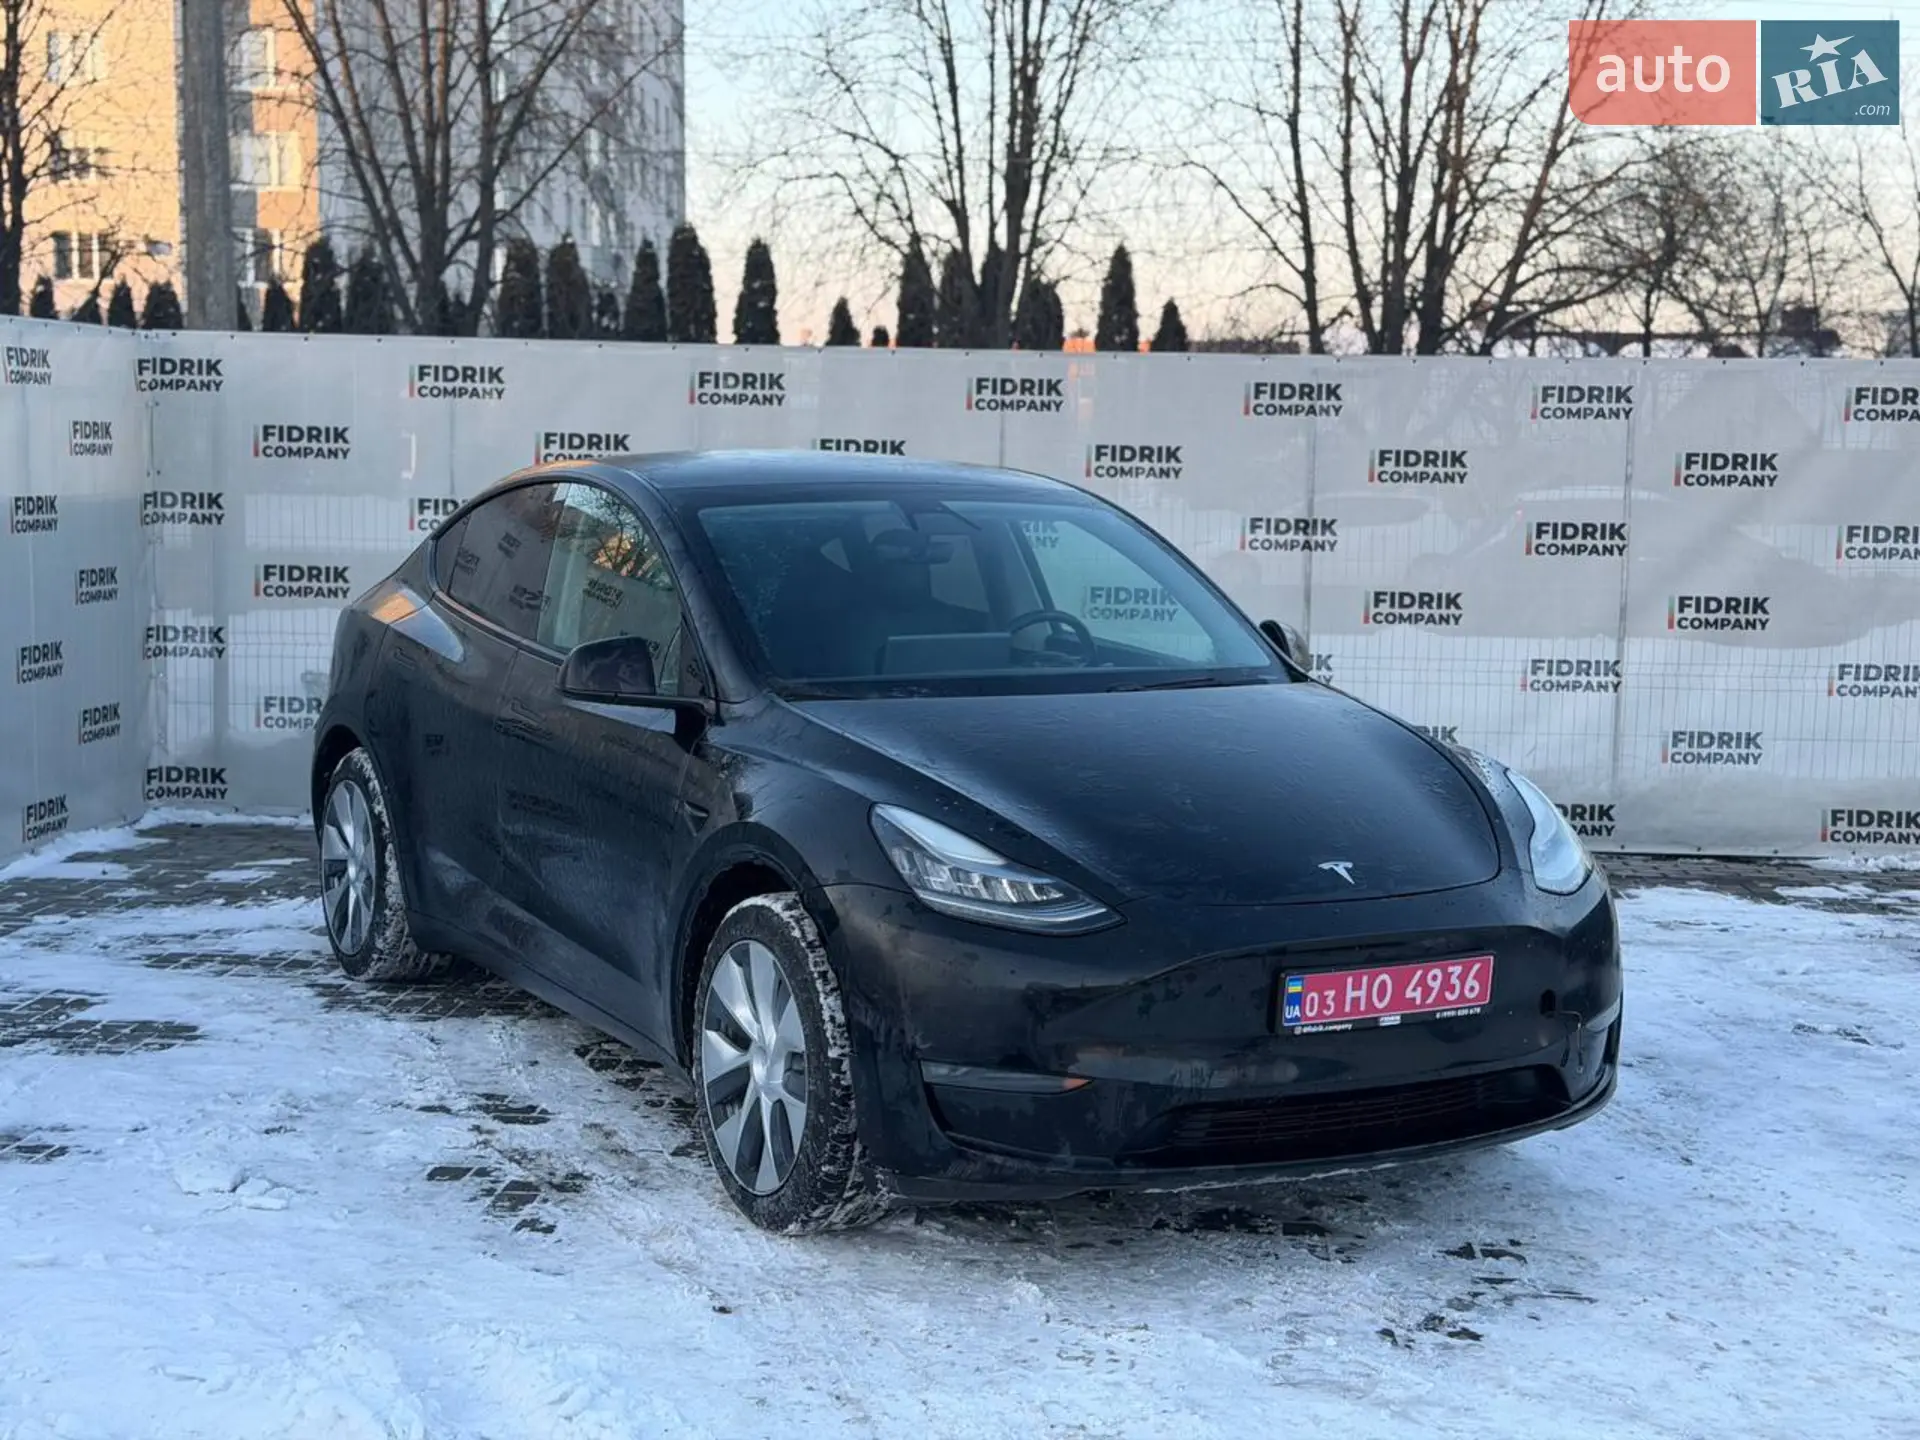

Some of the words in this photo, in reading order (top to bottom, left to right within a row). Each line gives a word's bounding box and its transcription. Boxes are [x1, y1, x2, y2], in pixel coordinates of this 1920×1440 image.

[5, 346, 51, 369] FIDRIK
[137, 357, 223, 377] FIDRIK
[9, 370, 52, 386] COMPANY
[418, 364, 504, 385] FIDRIK
[698, 371, 785, 392] FIDRIK
[139, 378, 224, 392] COMPANY
[417, 385, 505, 400] COMPANY
[976, 377, 1064, 397] FIDRIK
[1253, 382, 1342, 402] FIDRIK
[1541, 385, 1633, 405] FIDRIK
[697, 392, 786, 407] COMPANY
[975, 398, 1064, 413] COMPANY
[1252, 403, 1343, 418] COMPANY
[1540, 406, 1634, 421] COMPANY
[72, 420, 112, 440] FIDRIK
[262, 424, 350, 445] FIDRIK
[73, 443, 113, 456] COMPANY
[543, 432, 631, 452] FIDRIK
[262, 445, 351, 460] COMPANY
[1095, 444, 1183, 464] FIDRIK
[1378, 449, 1468, 469] FIDRIK
[1685, 452, 1779, 472] FIDRIK
[1094, 465, 1183, 480] COMPANY
[1377, 470, 1468, 484] COMPANY
[1684, 473, 1779, 488] COMPANY
[14, 494, 59, 516] FIDRIK
[143, 490, 225, 510] FIDRIK
[418, 498, 468, 516] FID
[15, 517, 59, 534] COMPANY
[143, 511, 226, 526] COMPANY
[1249, 517, 1338, 537] FIDRIK
[1535, 521, 1627, 541] FIDRIK
[1249, 538, 1338, 552] COMPANY
[1534, 542, 1627, 557] COMPANY
[79, 566, 118, 588] FIDRIK
[263, 564, 349, 584] FIDRIK
[79, 588, 119, 605] COMPANY
[263, 584, 350, 599] COMPANY
[1373, 590, 1463, 610] FIDRIK
[1089, 606, 1179, 622] COMPANY
[1678, 595, 1771, 615] FIDRIK
[1372, 612, 1463, 626] COMPANY
[1677, 616, 1771, 632] COMPANY
[146, 624, 226, 644] FIDRIK
[20, 640, 63, 667] FIDRIK
[146, 645, 226, 660] COMPANY
[20, 663, 64, 684] COMPANY
[1530, 658, 1622, 678] FIDRIK
[1529, 679, 1622, 694] COMPANY
[1836, 684, 1920, 698] COMPAN
[83, 702, 120, 728] FIDRIK
[263, 715, 318, 729] COMP
[82, 724, 121, 744] COMPANY
[1672, 730, 1763, 750] FIDRIK
[1671, 751, 1763, 765] COMPANY
[146, 765, 227, 785] FIDRIK
[146, 785, 228, 801] COMPANY
[26, 794, 69, 824] FIDRIK
[1831, 809, 1920, 829] FIDRIK
[26, 815, 70, 841] COMPANY
[1304, 990, 1336, 1017] 03
[1344, 973, 1393, 1013] HO
[1405, 962, 1481, 1006] 4936
[1285, 1005, 1301, 1019] UA
